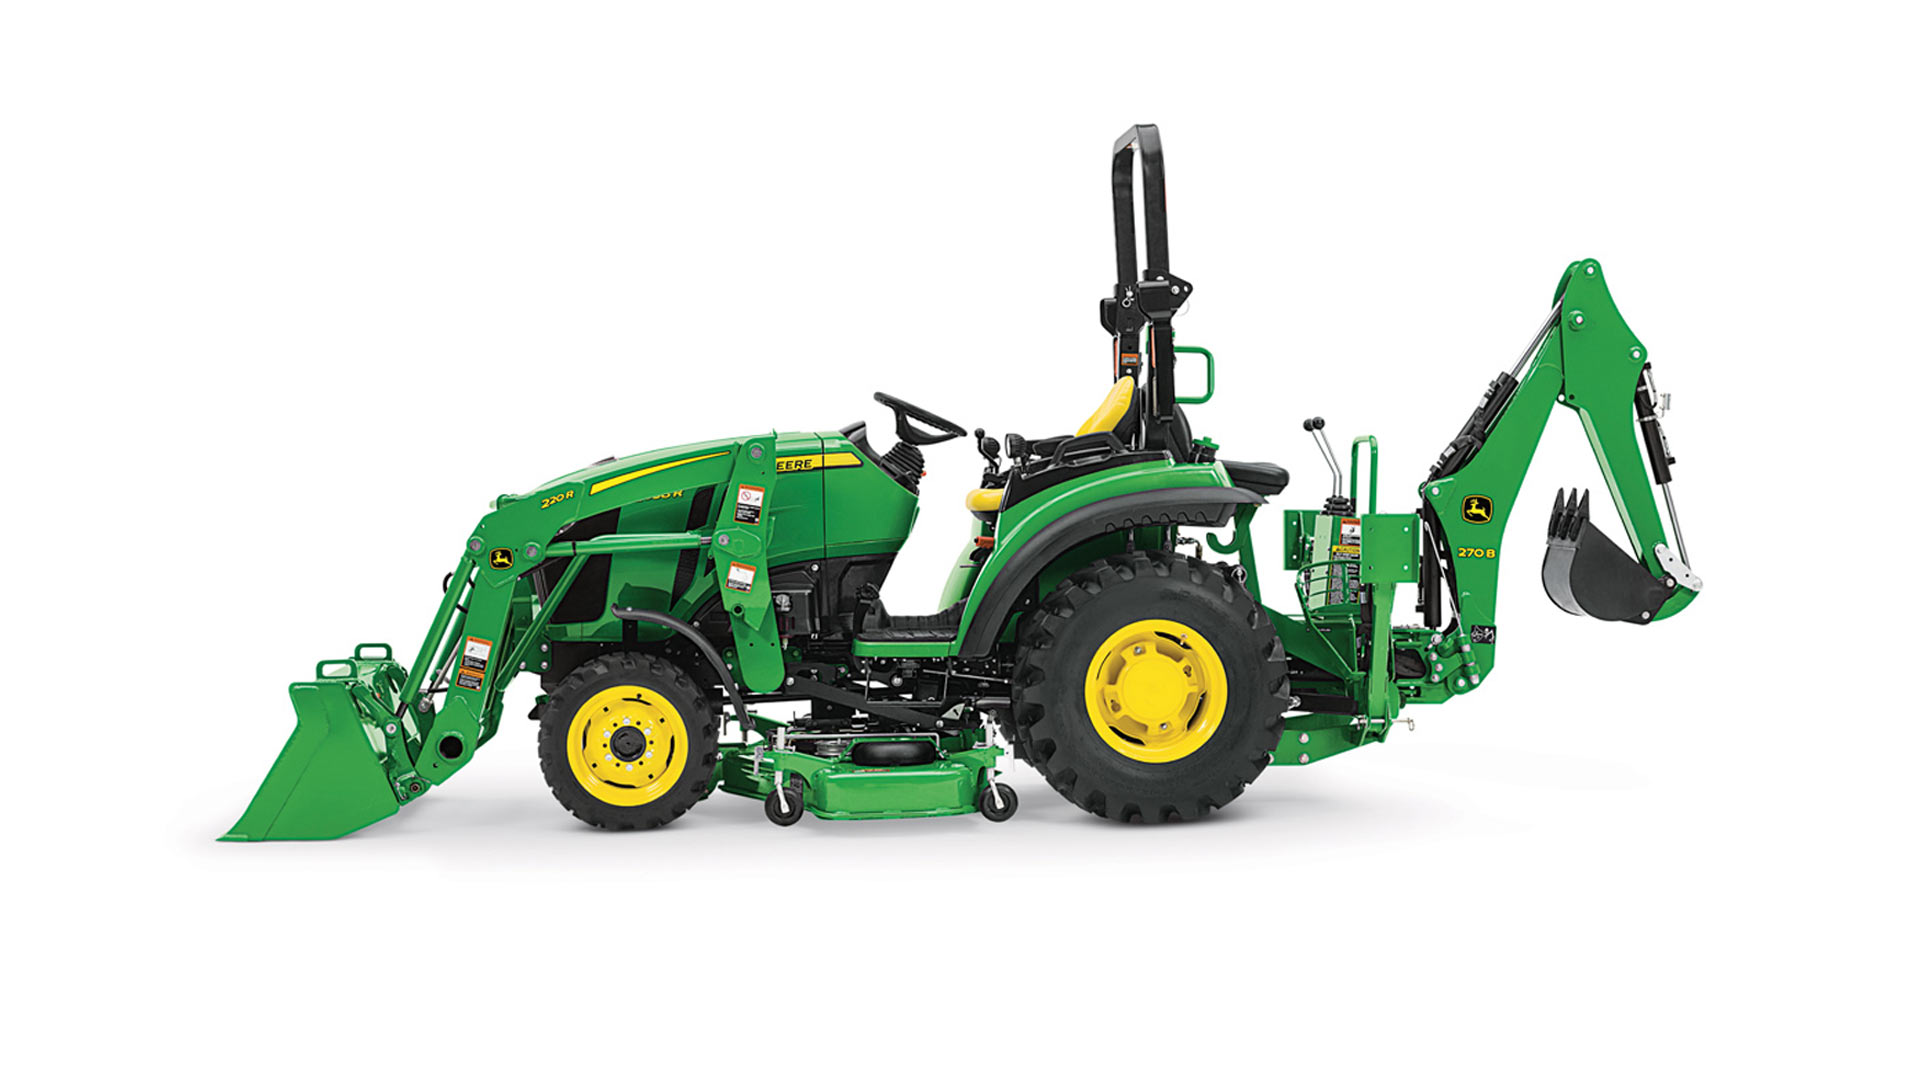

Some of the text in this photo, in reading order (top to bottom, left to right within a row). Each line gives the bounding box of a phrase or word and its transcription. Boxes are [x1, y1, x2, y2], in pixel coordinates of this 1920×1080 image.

[776, 459, 813, 470] EERE
[541, 489, 574, 509] 220 R
[1457, 547, 1496, 559] 270 B
